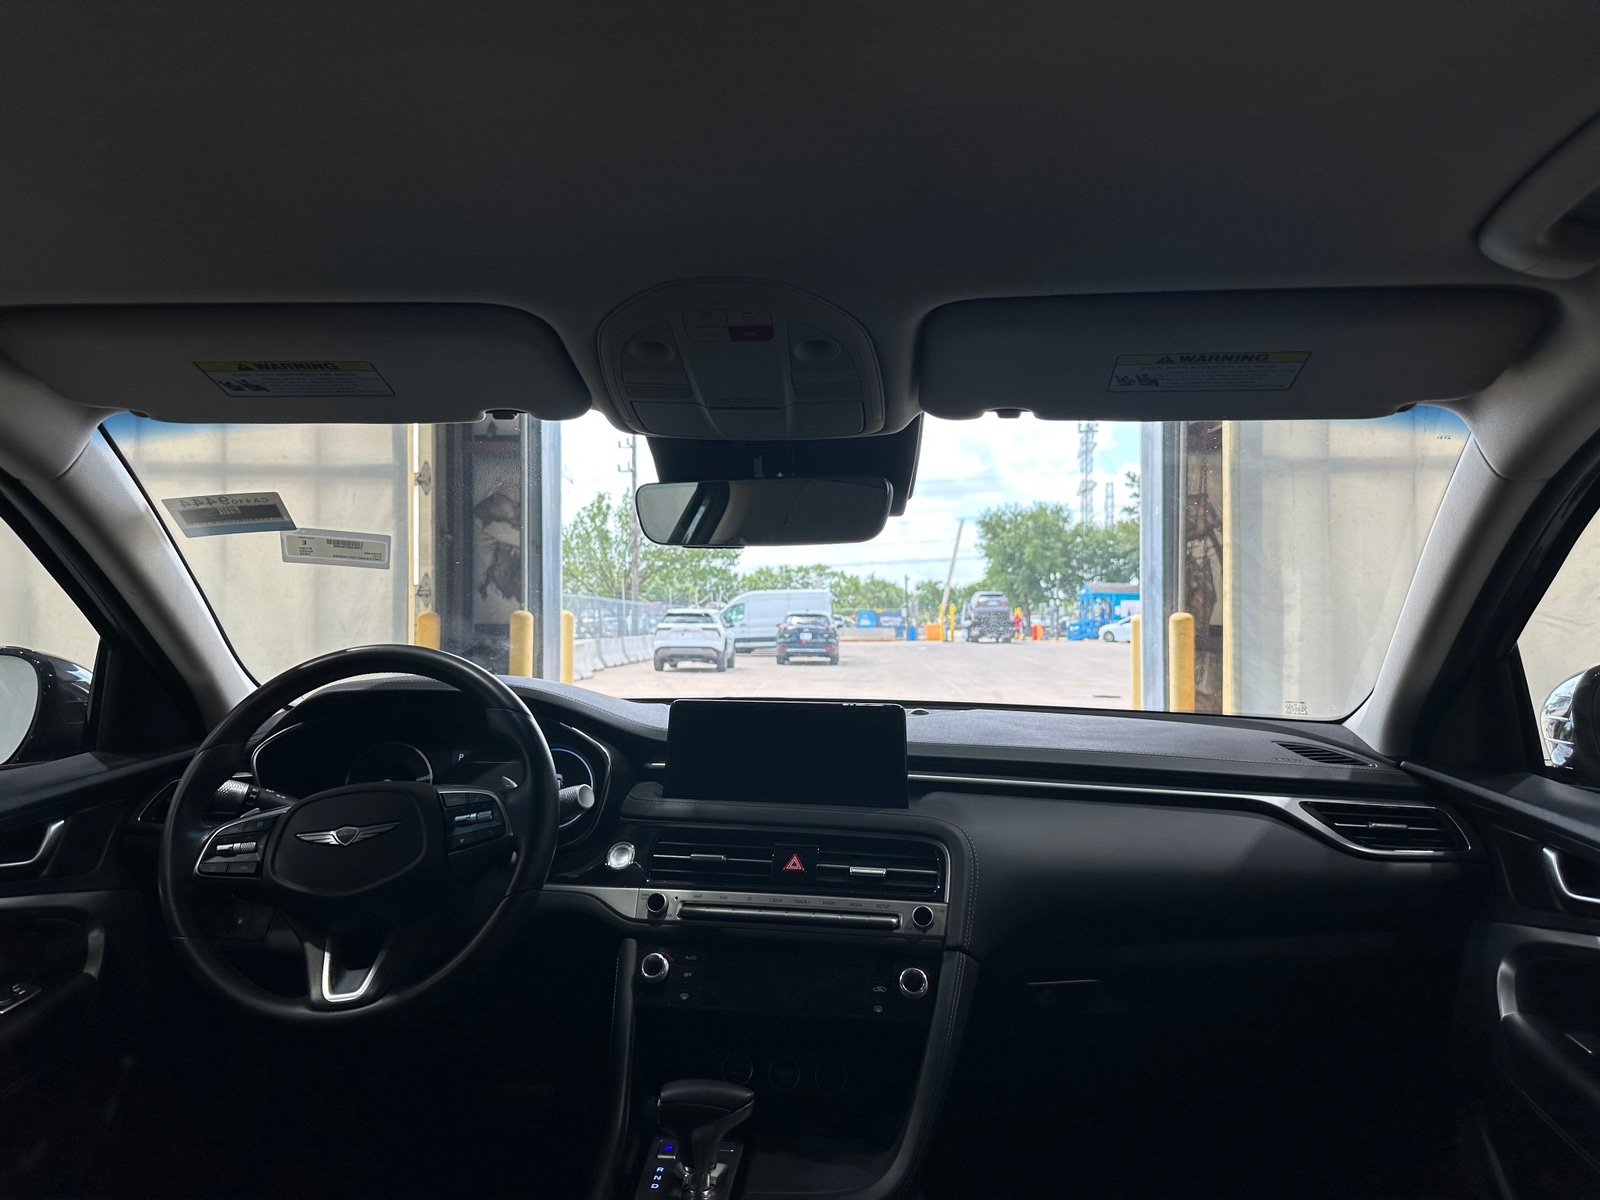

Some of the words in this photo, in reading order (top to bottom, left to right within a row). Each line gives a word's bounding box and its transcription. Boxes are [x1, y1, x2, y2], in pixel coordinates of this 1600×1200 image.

[1179, 353, 1270, 363] WARNING
[254, 362, 339, 371] WARNING
[458, 753, 464, 762] P
